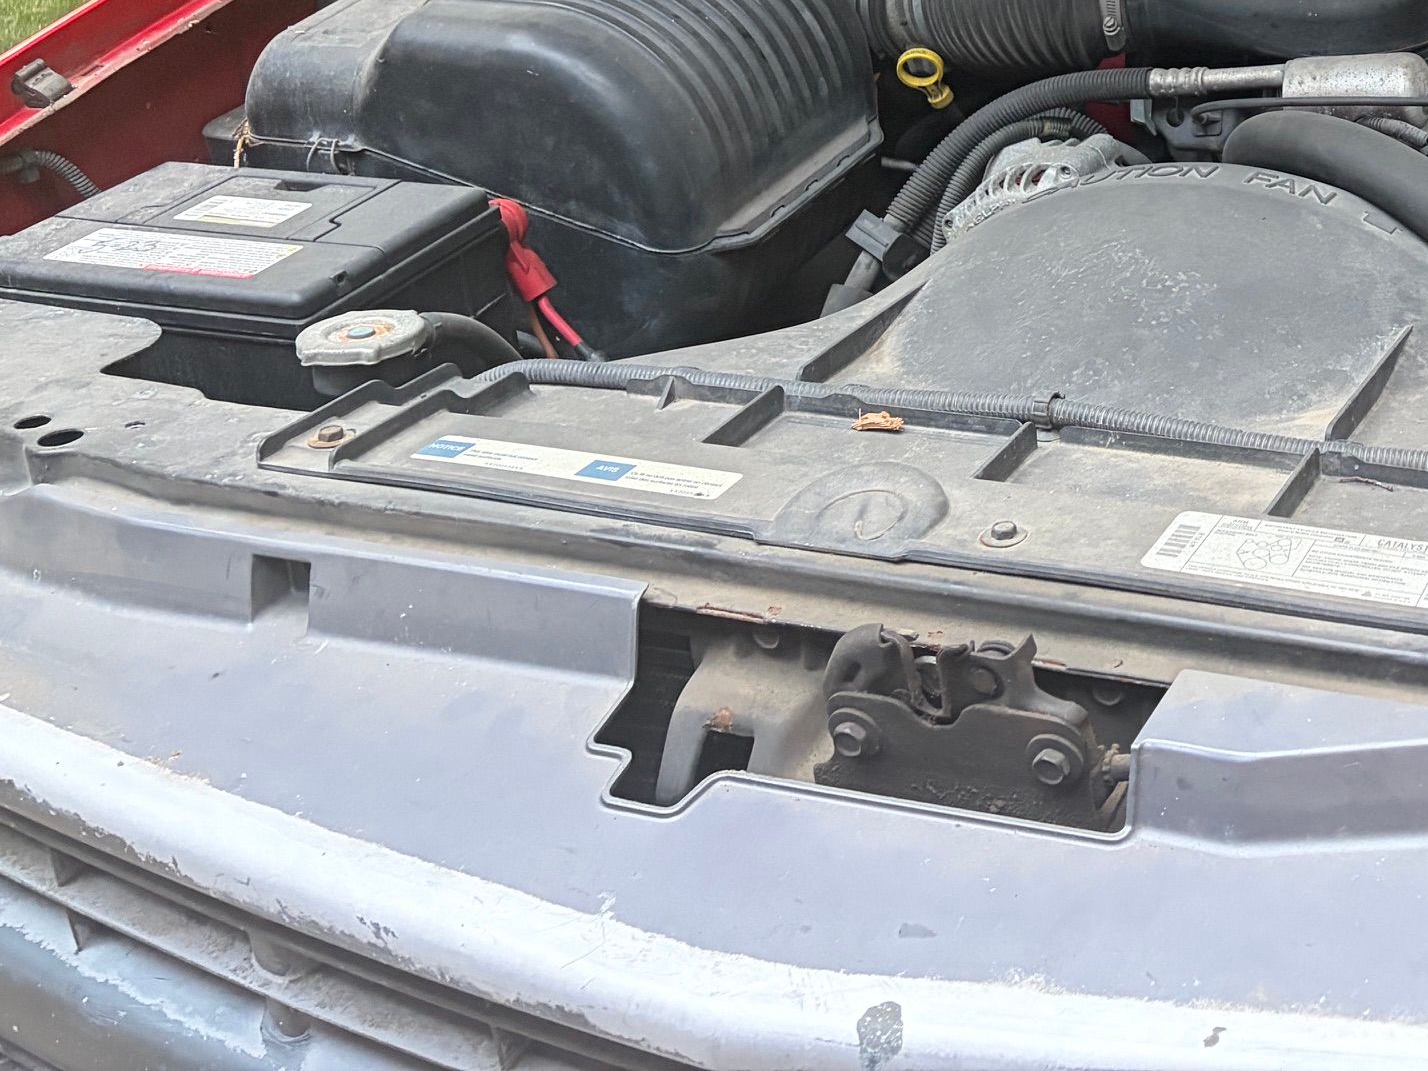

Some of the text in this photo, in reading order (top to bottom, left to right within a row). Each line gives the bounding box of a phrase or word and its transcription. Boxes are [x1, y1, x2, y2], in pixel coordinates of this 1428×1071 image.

[1242, 171, 1338, 206] FAN
[428, 442, 466, 452] NOTICE
[596, 464, 620, 473] AVIS
